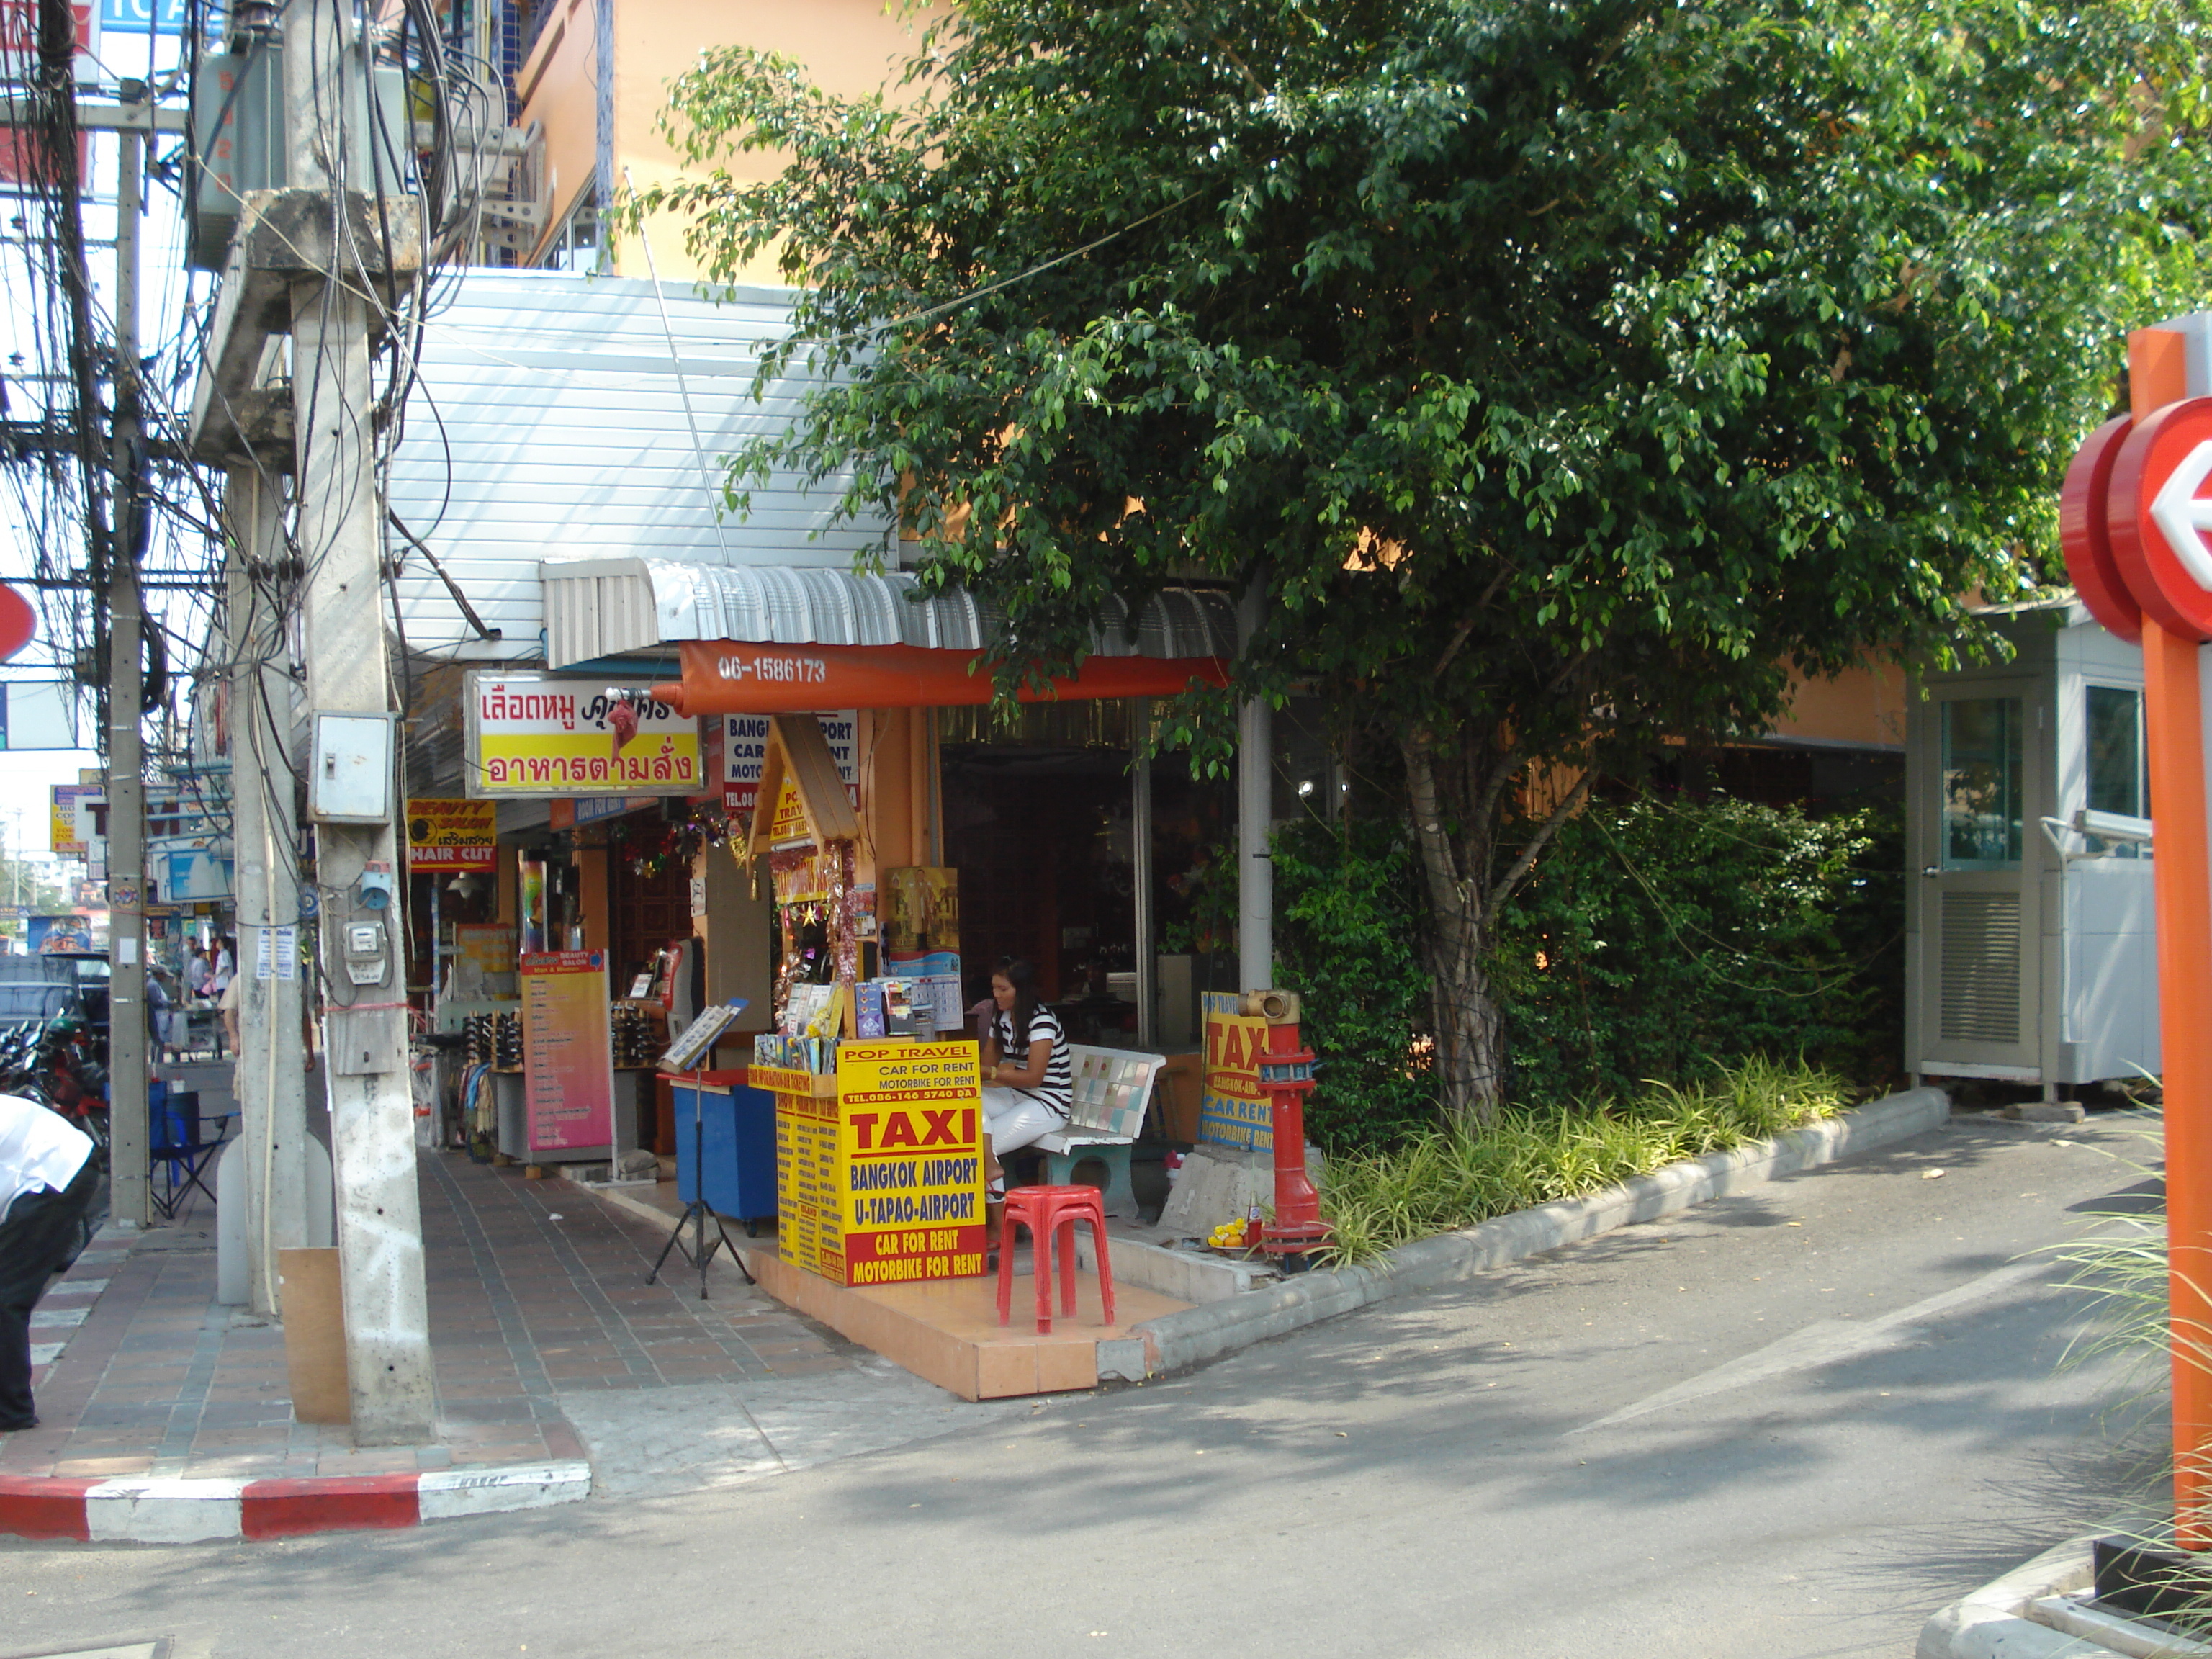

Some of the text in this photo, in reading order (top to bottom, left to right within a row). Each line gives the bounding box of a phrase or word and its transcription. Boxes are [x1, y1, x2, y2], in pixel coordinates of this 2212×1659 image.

[717, 656, 826, 683] 06-1586173
[729, 719, 852, 741] BANG PORT
[487, 736, 692, 782] อาหารตามสั่ง
[734, 744, 764, 758] CAR
[408, 801, 488, 815] BEAUTY
[437, 817, 493, 829] SALON
[410, 848, 493, 861] HAIR CUT
[845, 1046, 972, 1060] POP TRAVEL
[1207, 1021, 1266, 1071] TAX
[879, 1062, 975, 1076] CAR FOR RENT
[879, 1076, 976, 1090] MOTORBIKE FOR RENT
[848, 1089, 972, 1103] TEL.086-146 5740 DA
[1202, 1094, 1235, 1116] CAR
[849, 1108, 976, 1149] TAXI
[850, 1158, 978, 1192] BANGKOK AIRPORT
[855, 1192, 975, 1226] U-TAPAO-AIRPORT
[875, 1229, 958, 1256] CAR FOR RENT
[853, 1257, 922, 1284] MOTORBIKE
[927, 1256, 950, 1278] FOR
[953, 1253, 982, 1276] RENT
